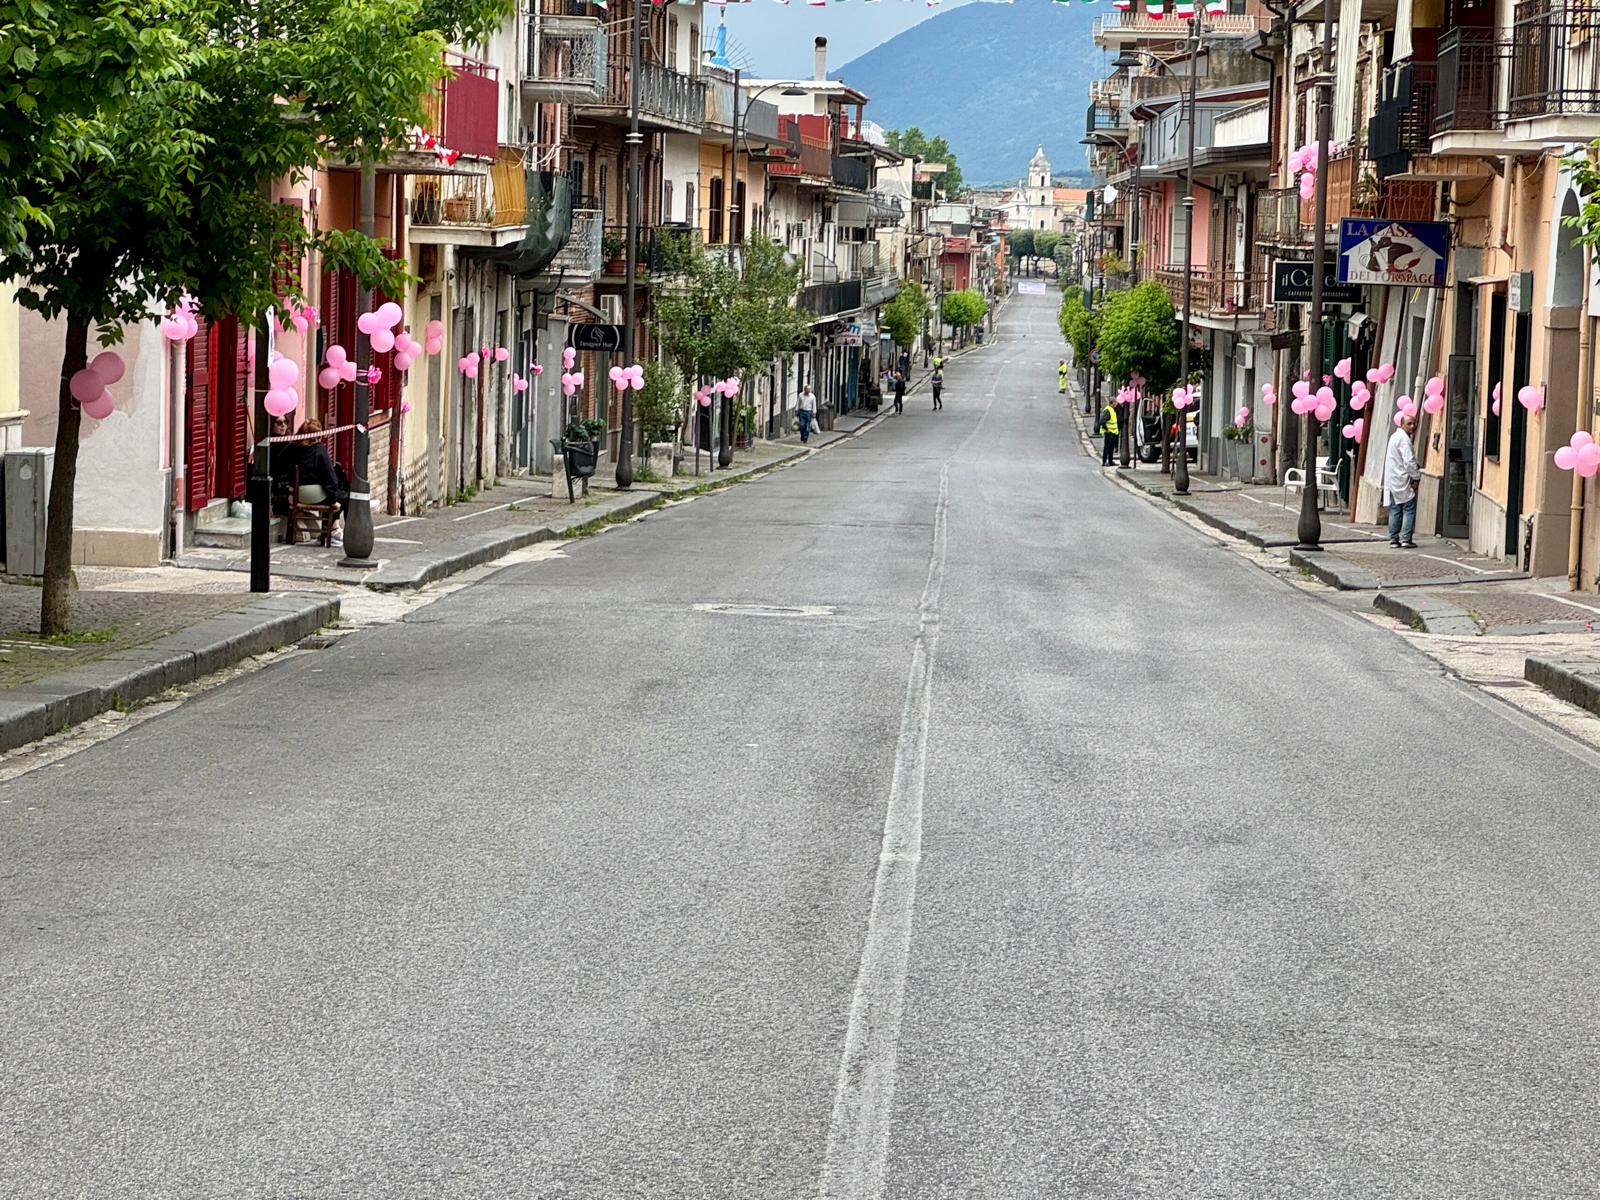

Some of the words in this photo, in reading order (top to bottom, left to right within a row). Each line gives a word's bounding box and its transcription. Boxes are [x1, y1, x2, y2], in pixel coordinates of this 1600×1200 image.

[1346, 222, 1369, 236] LA
[1373, 223, 1416, 238] CASA
[1350, 270, 1370, 281] DEI
